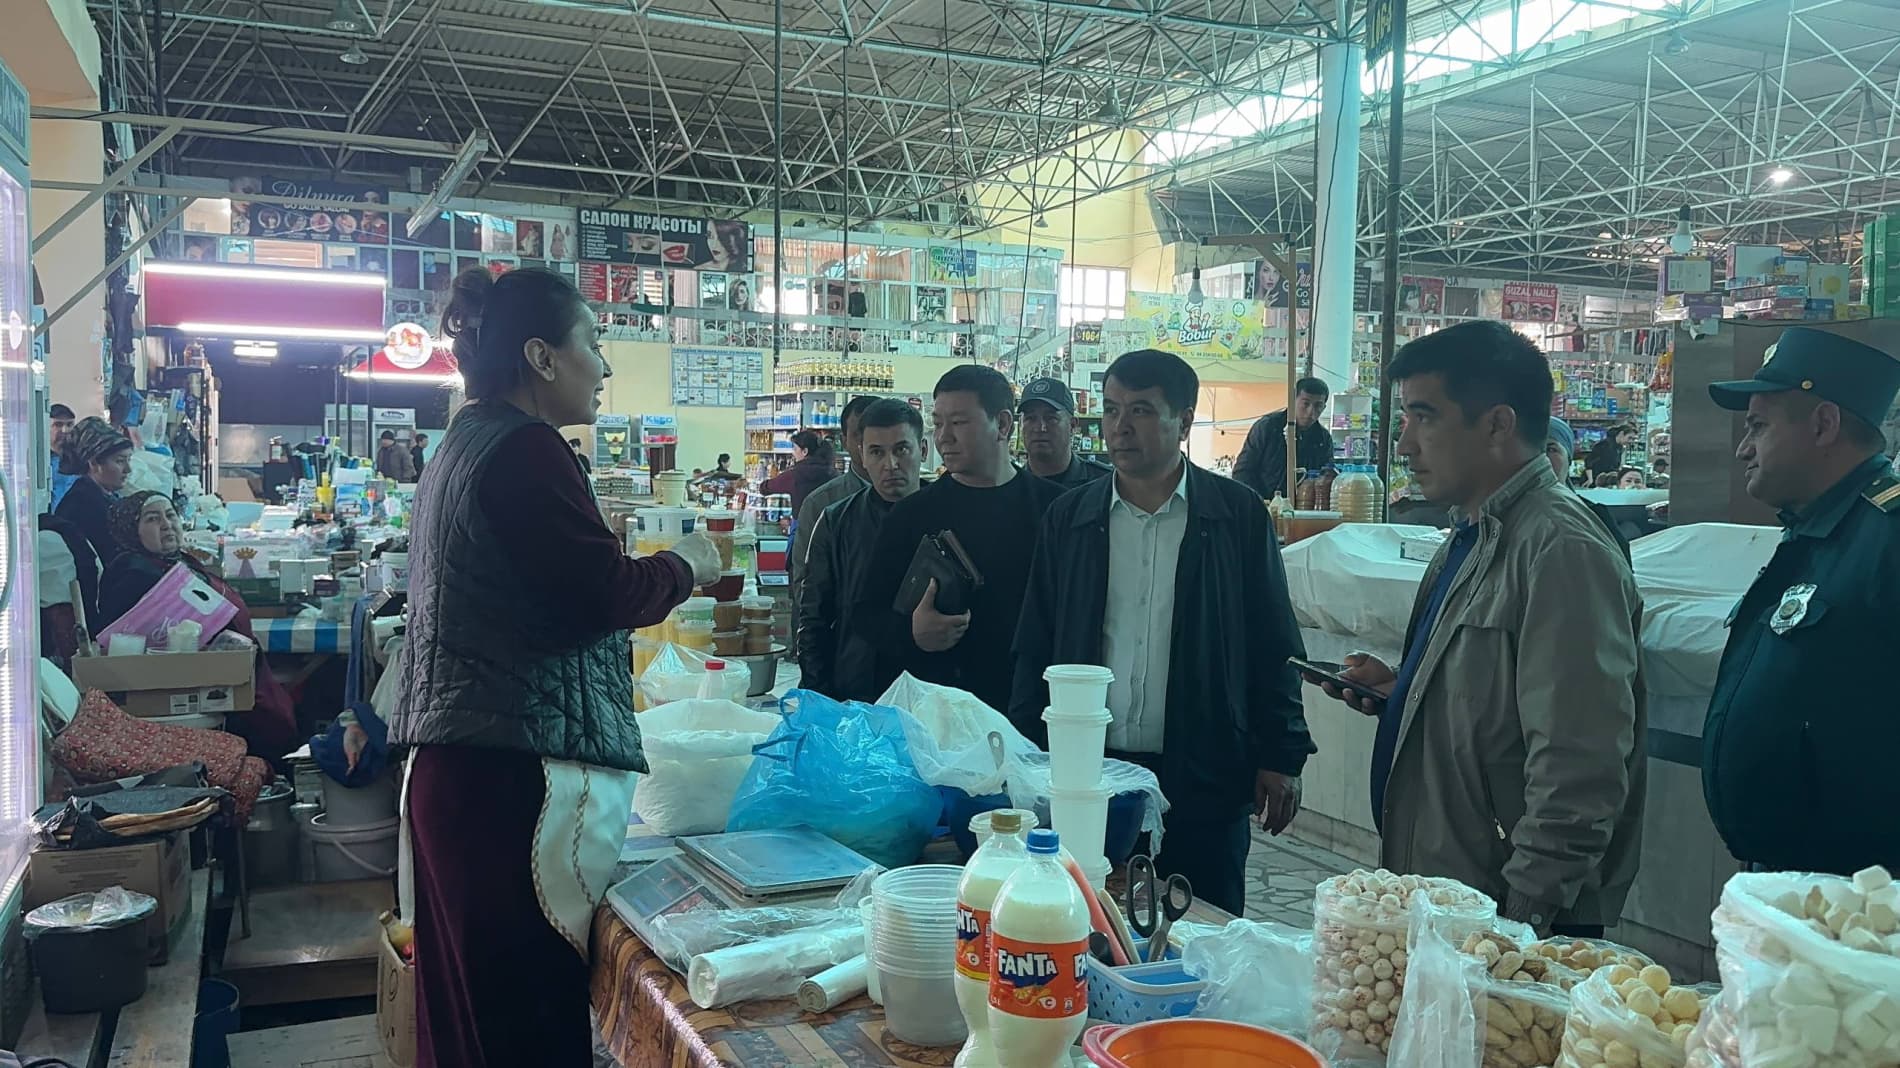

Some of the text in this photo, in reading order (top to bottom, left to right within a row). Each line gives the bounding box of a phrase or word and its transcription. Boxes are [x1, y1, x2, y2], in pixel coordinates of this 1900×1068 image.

[580, 209, 702, 234] САЛОН КРАСОТЫ
[1505, 285, 1531, 297] GUZAL
[1532, 287, 1556, 298] NAILS
[1179, 328, 1216, 343] Bobur
[997, 948, 1058, 977] FANTA
